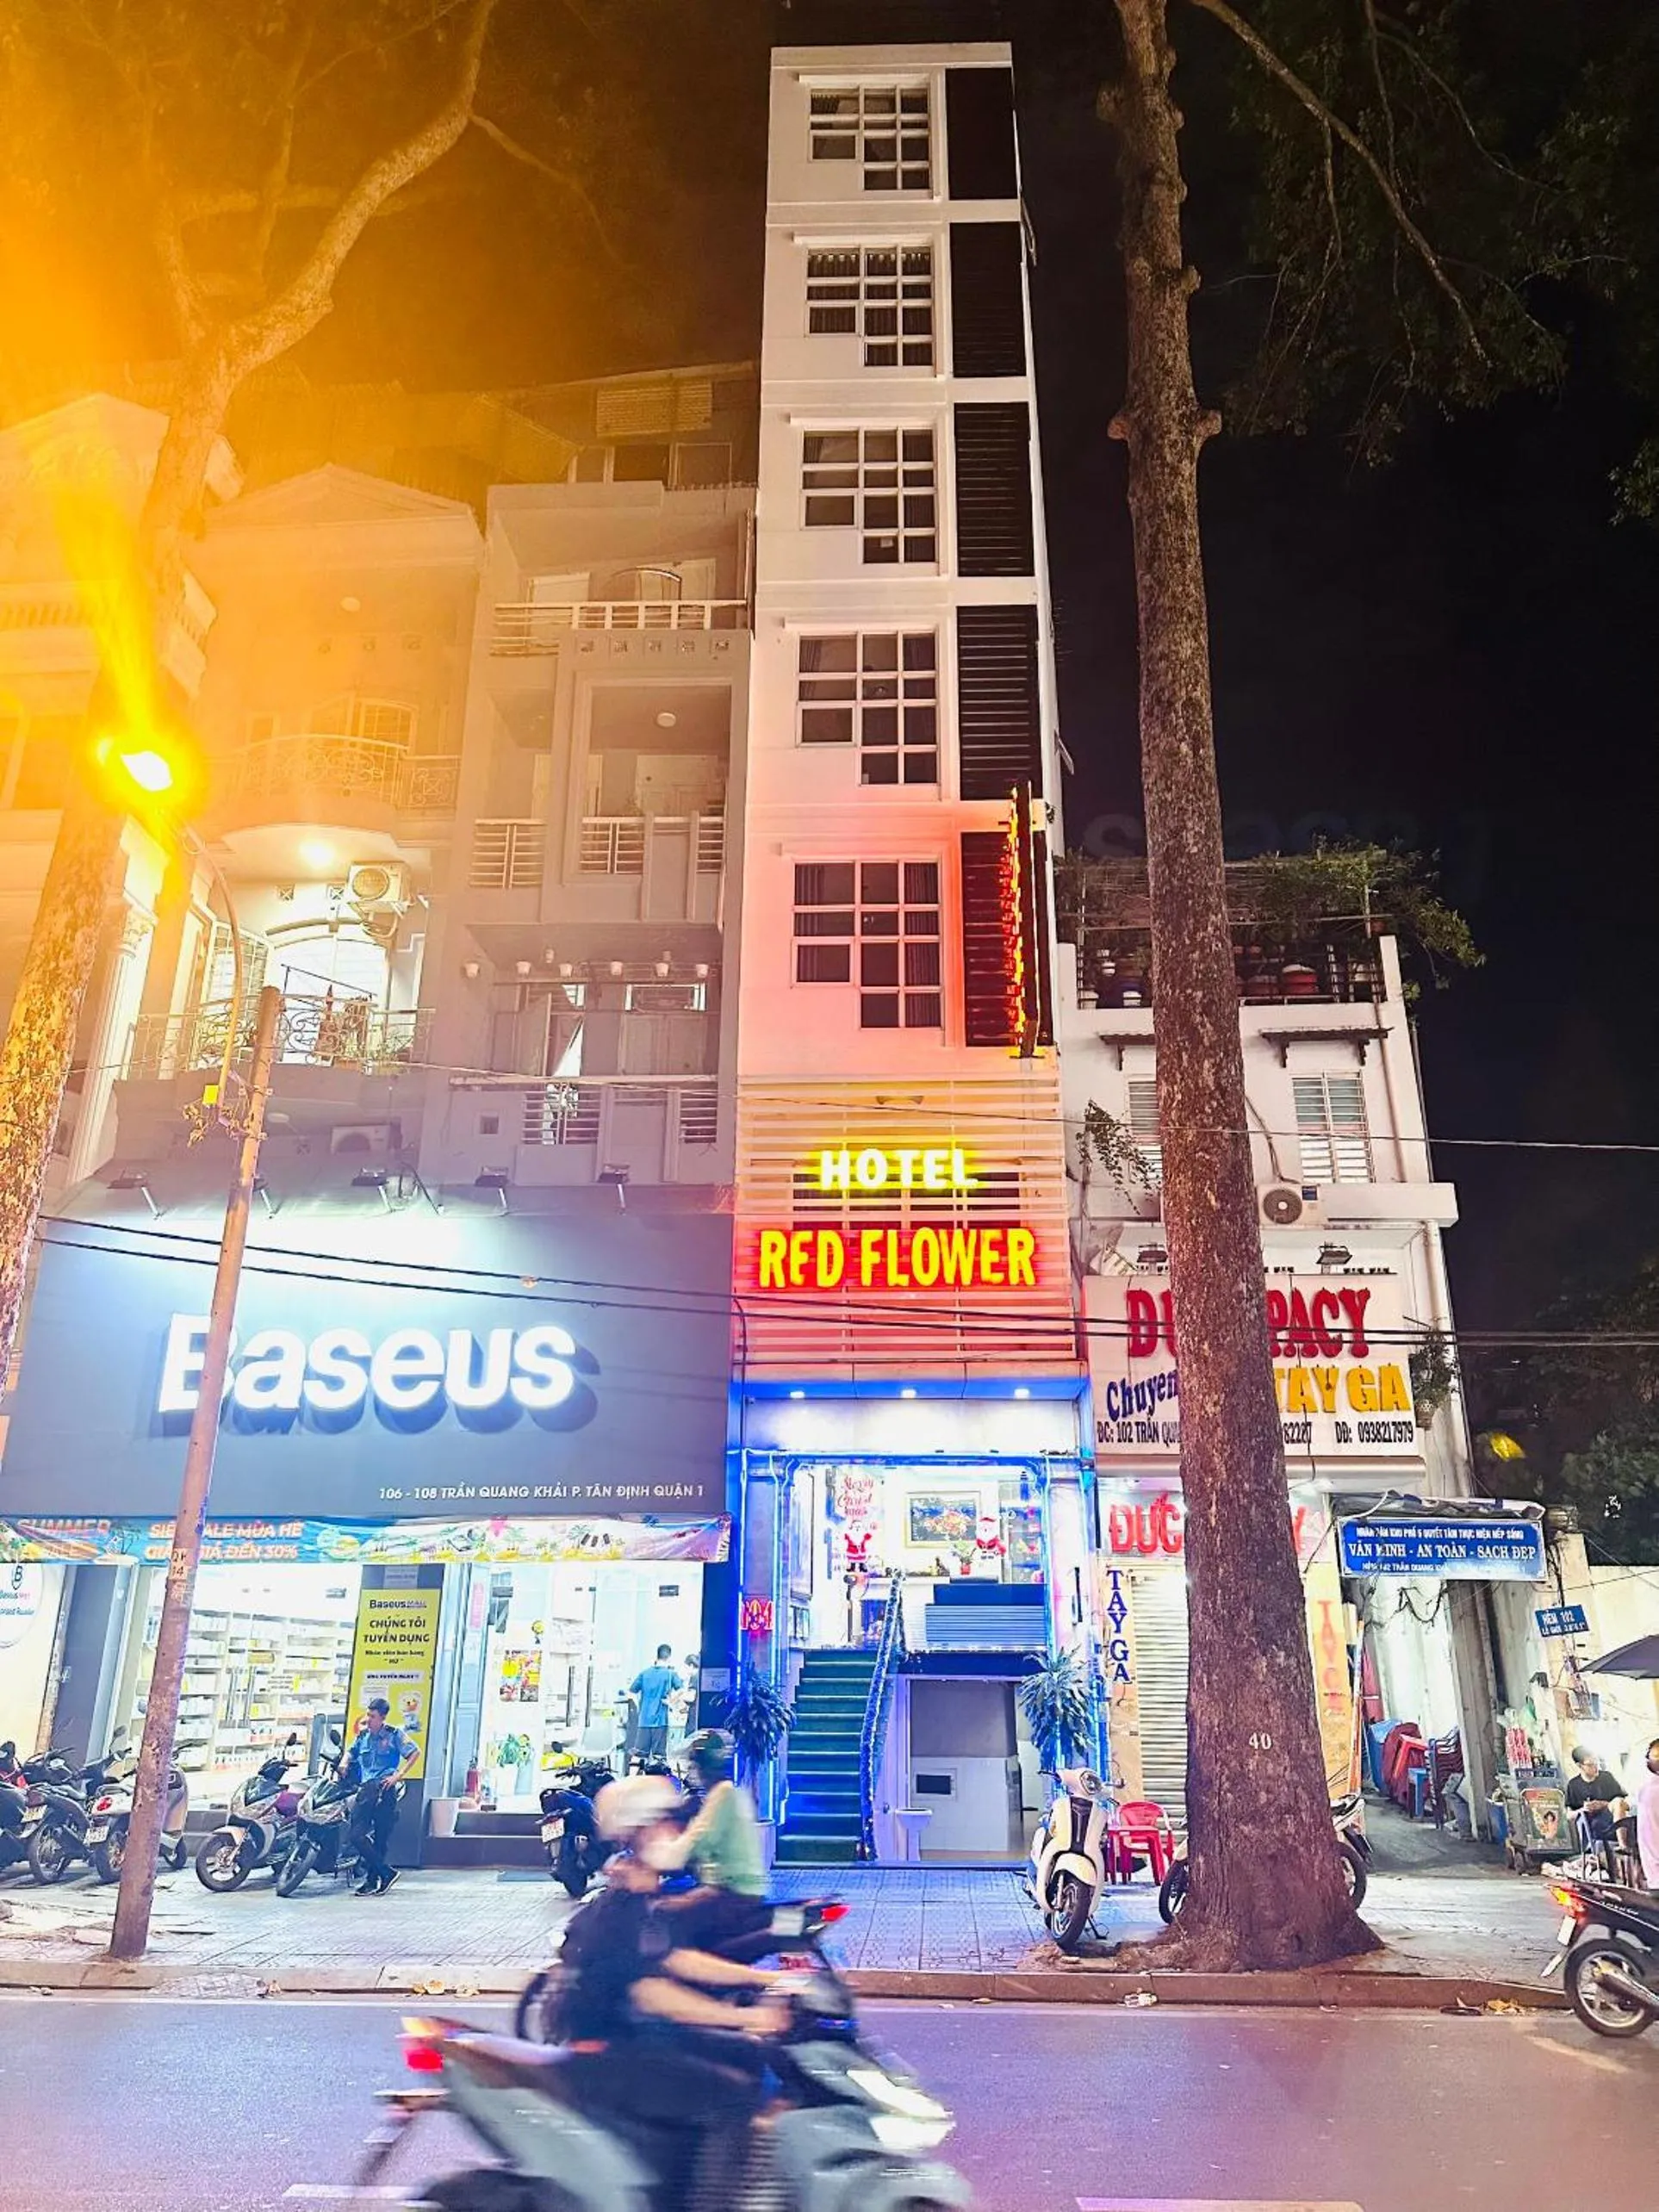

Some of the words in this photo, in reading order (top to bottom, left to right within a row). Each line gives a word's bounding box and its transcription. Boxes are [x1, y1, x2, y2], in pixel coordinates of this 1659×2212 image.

[821, 1148, 978, 1190] HOTEL
[758, 1230, 844, 1289] RED
[861, 1227, 1036, 1287] FLOWER
[158, 1313, 576, 1414] Baseus
[1346, 1364, 1411, 1414] GA
[1116, 1421, 1133, 1443] 102
[379, 1487, 402, 1500] 106
[414, 1487, 437, 1500] 108
[441, 1482, 475, 1499] TRẦN
[479, 1486, 529, 1499] QUANG
[534, 1482, 567, 1498] KHẢI
[572, 1486, 582, 1498] P.
[586, 1483, 612, 1497] TÂN
[616, 1486, 649, 1500] ĐỊNH
[653, 1482, 693, 1499] QUẬN
[697, 1486, 704, 1496] 1
[1417, 1544, 1432, 1558] AN
[1435, 1540, 1467, 1558] TOÀN
[370, 1616, 407, 1628] CHÚNG
[409, 1616, 426, 1628] TÔI
[399, 1634, 430, 1644] DỤNG
[1248, 1732, 1273, 1749] 40
